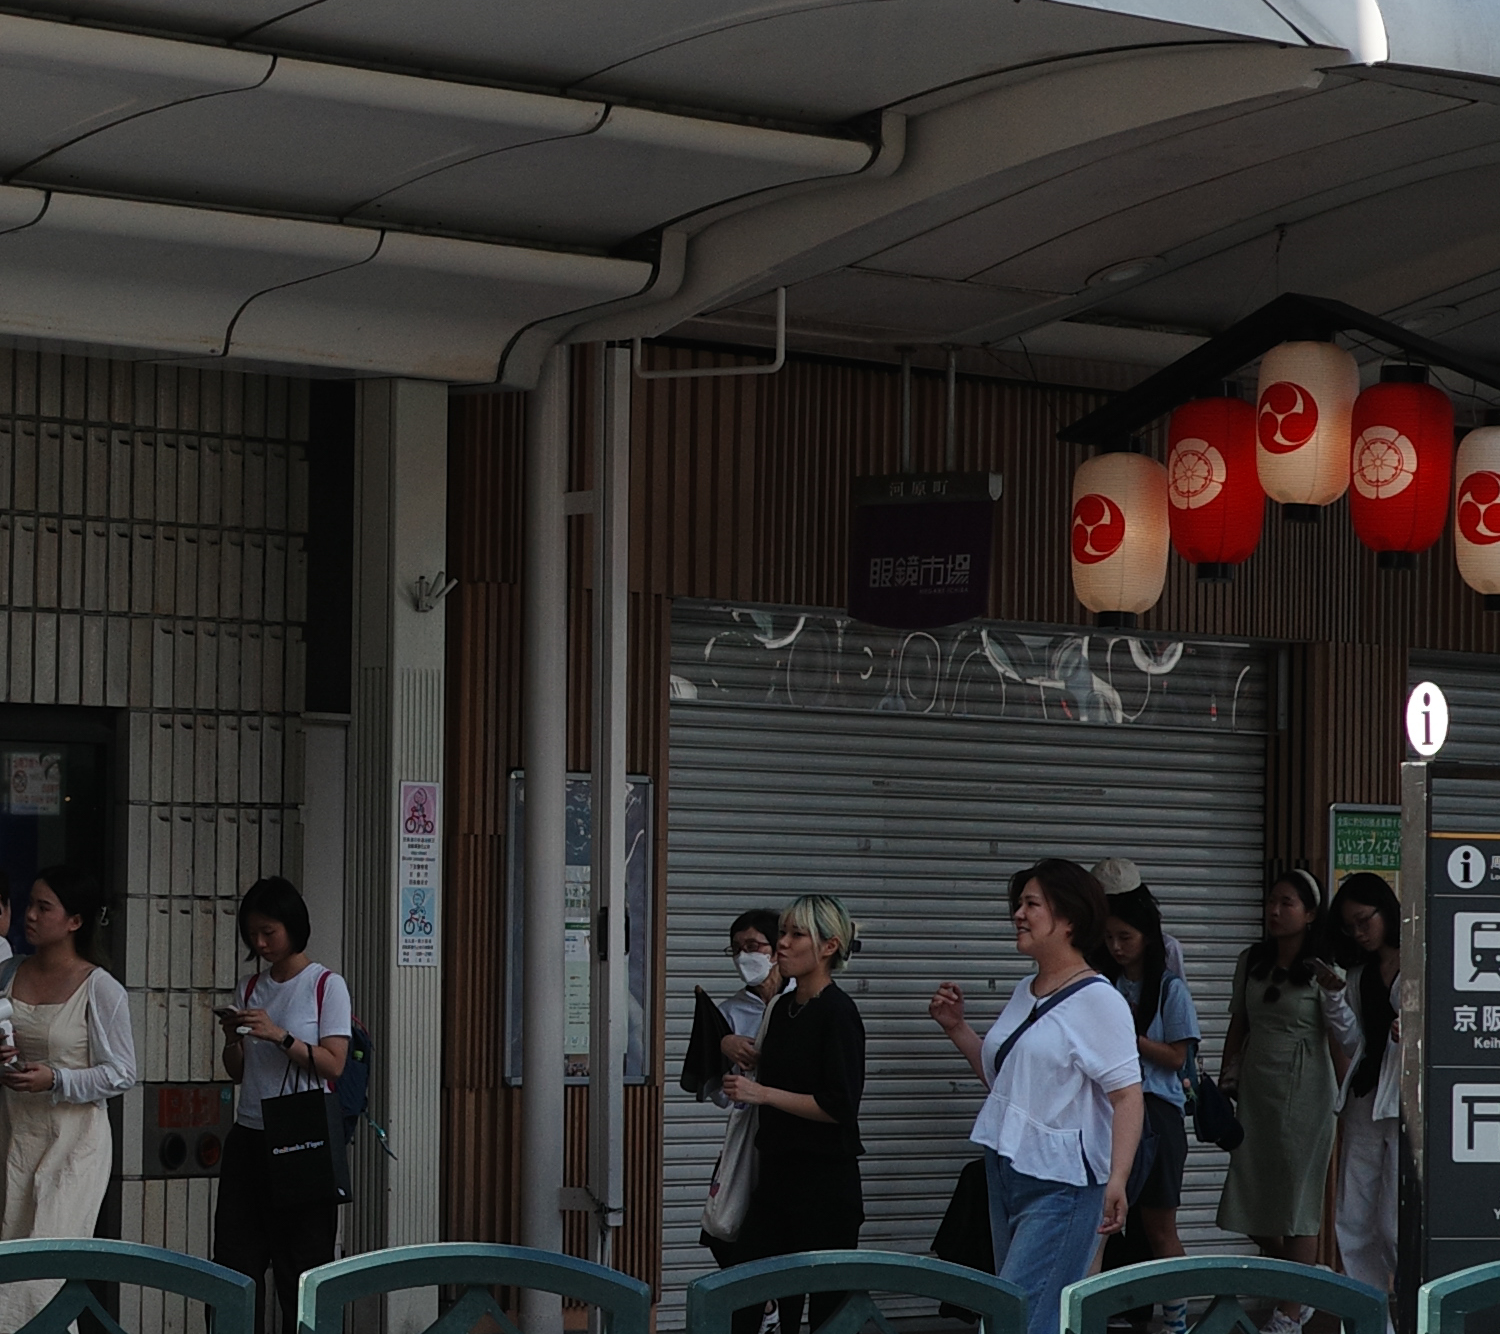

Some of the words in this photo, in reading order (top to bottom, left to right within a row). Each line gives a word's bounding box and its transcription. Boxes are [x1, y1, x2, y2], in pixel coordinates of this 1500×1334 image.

[889, 479, 949, 497] 河原町
[869, 553, 972, 588] 眼鏡市場
